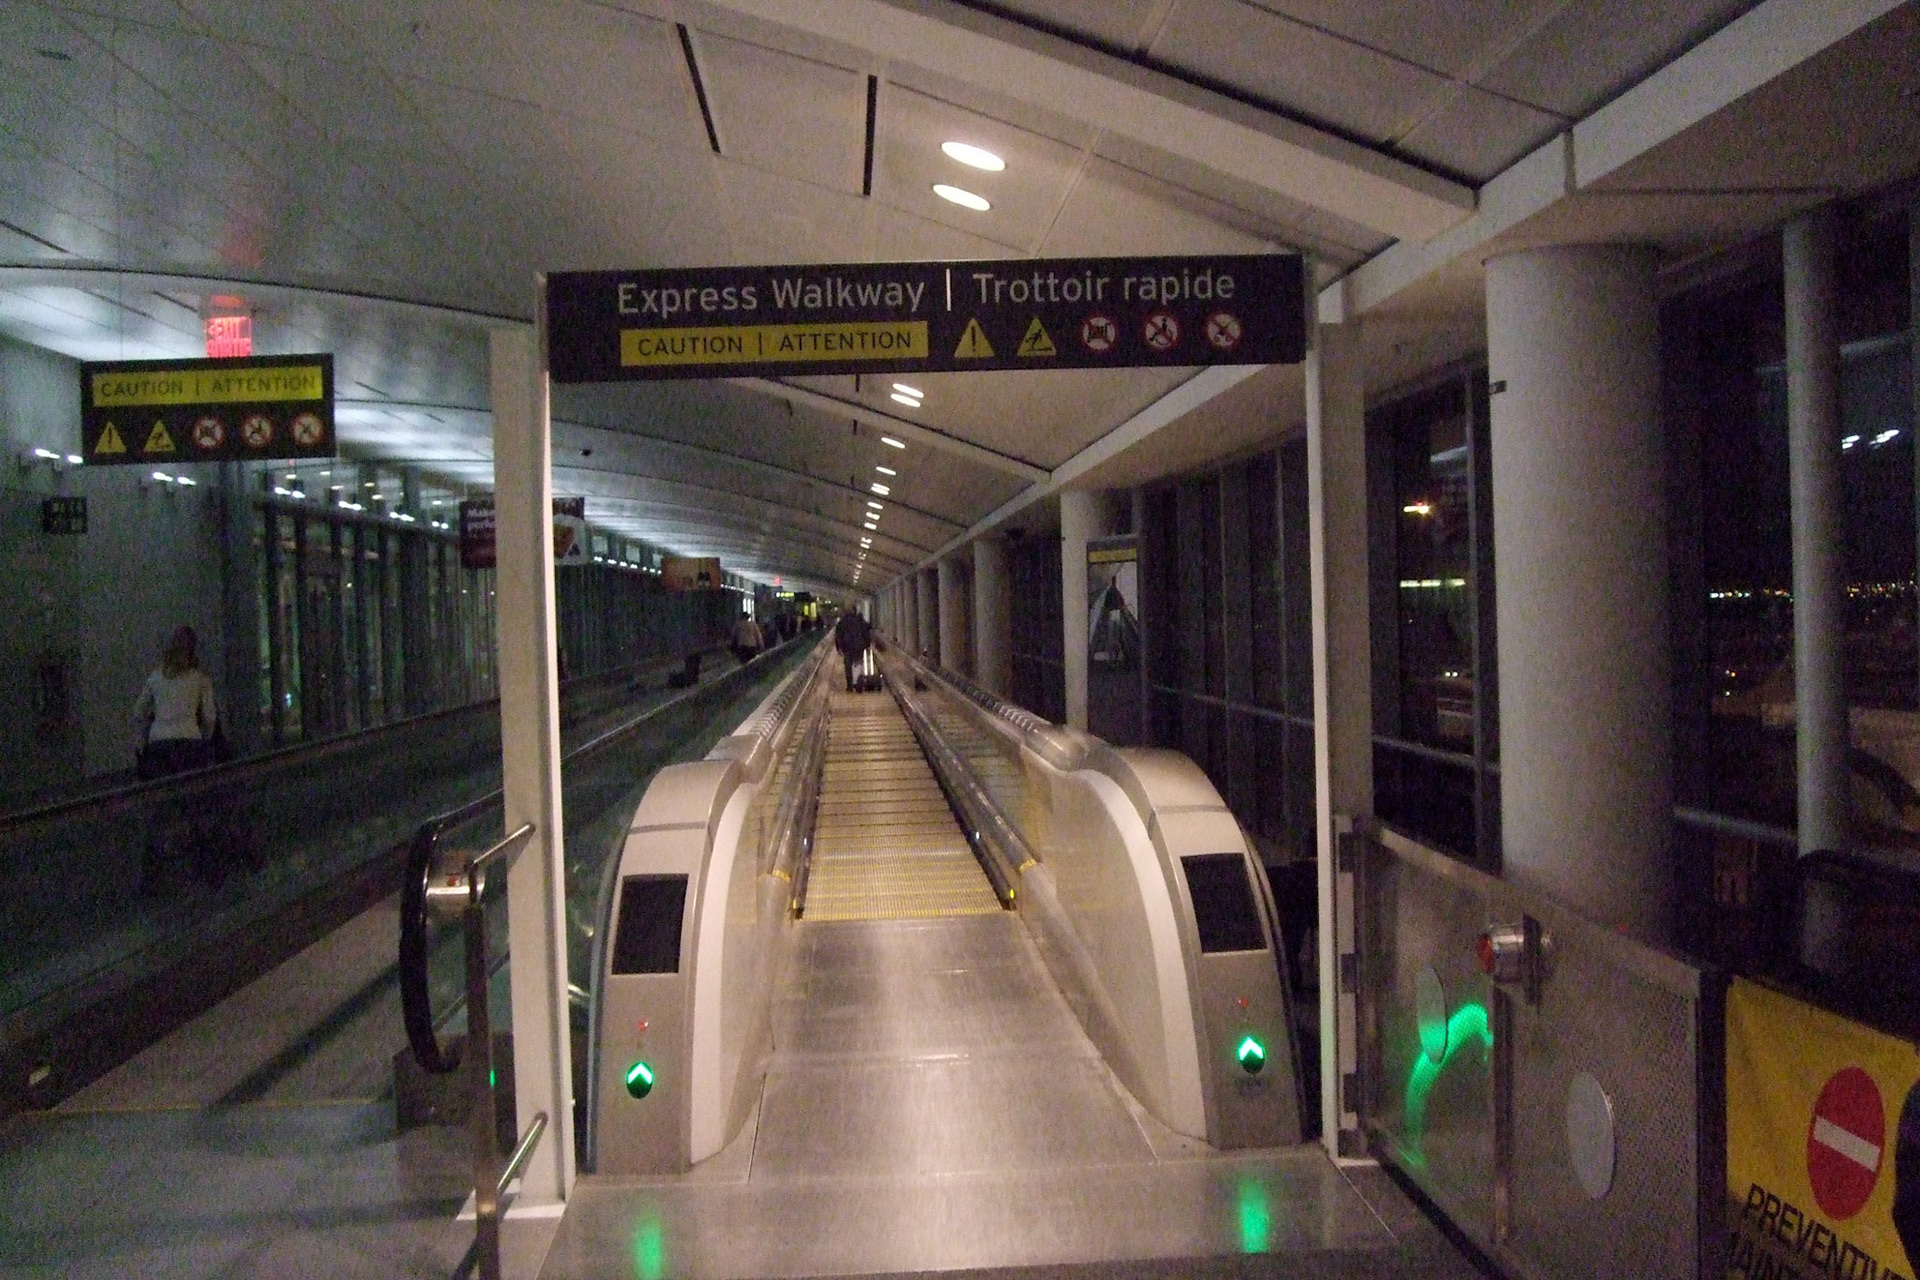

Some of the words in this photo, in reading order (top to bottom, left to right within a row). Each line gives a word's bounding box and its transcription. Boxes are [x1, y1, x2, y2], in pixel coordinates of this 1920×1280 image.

[617, 283, 757, 318] Express
[771, 277, 925, 312] Walkway
[972, 270, 1110, 303] Trottoir
[1123, 268, 1236, 304] rapide
[637, 334, 743, 357] CAUTION
[779, 331, 912, 352] ATTENTION
[100, 376, 184, 398] CAUTION
[211, 373, 315, 394] ATTENTION
[1744, 1183, 1907, 1280] PREVENTI
